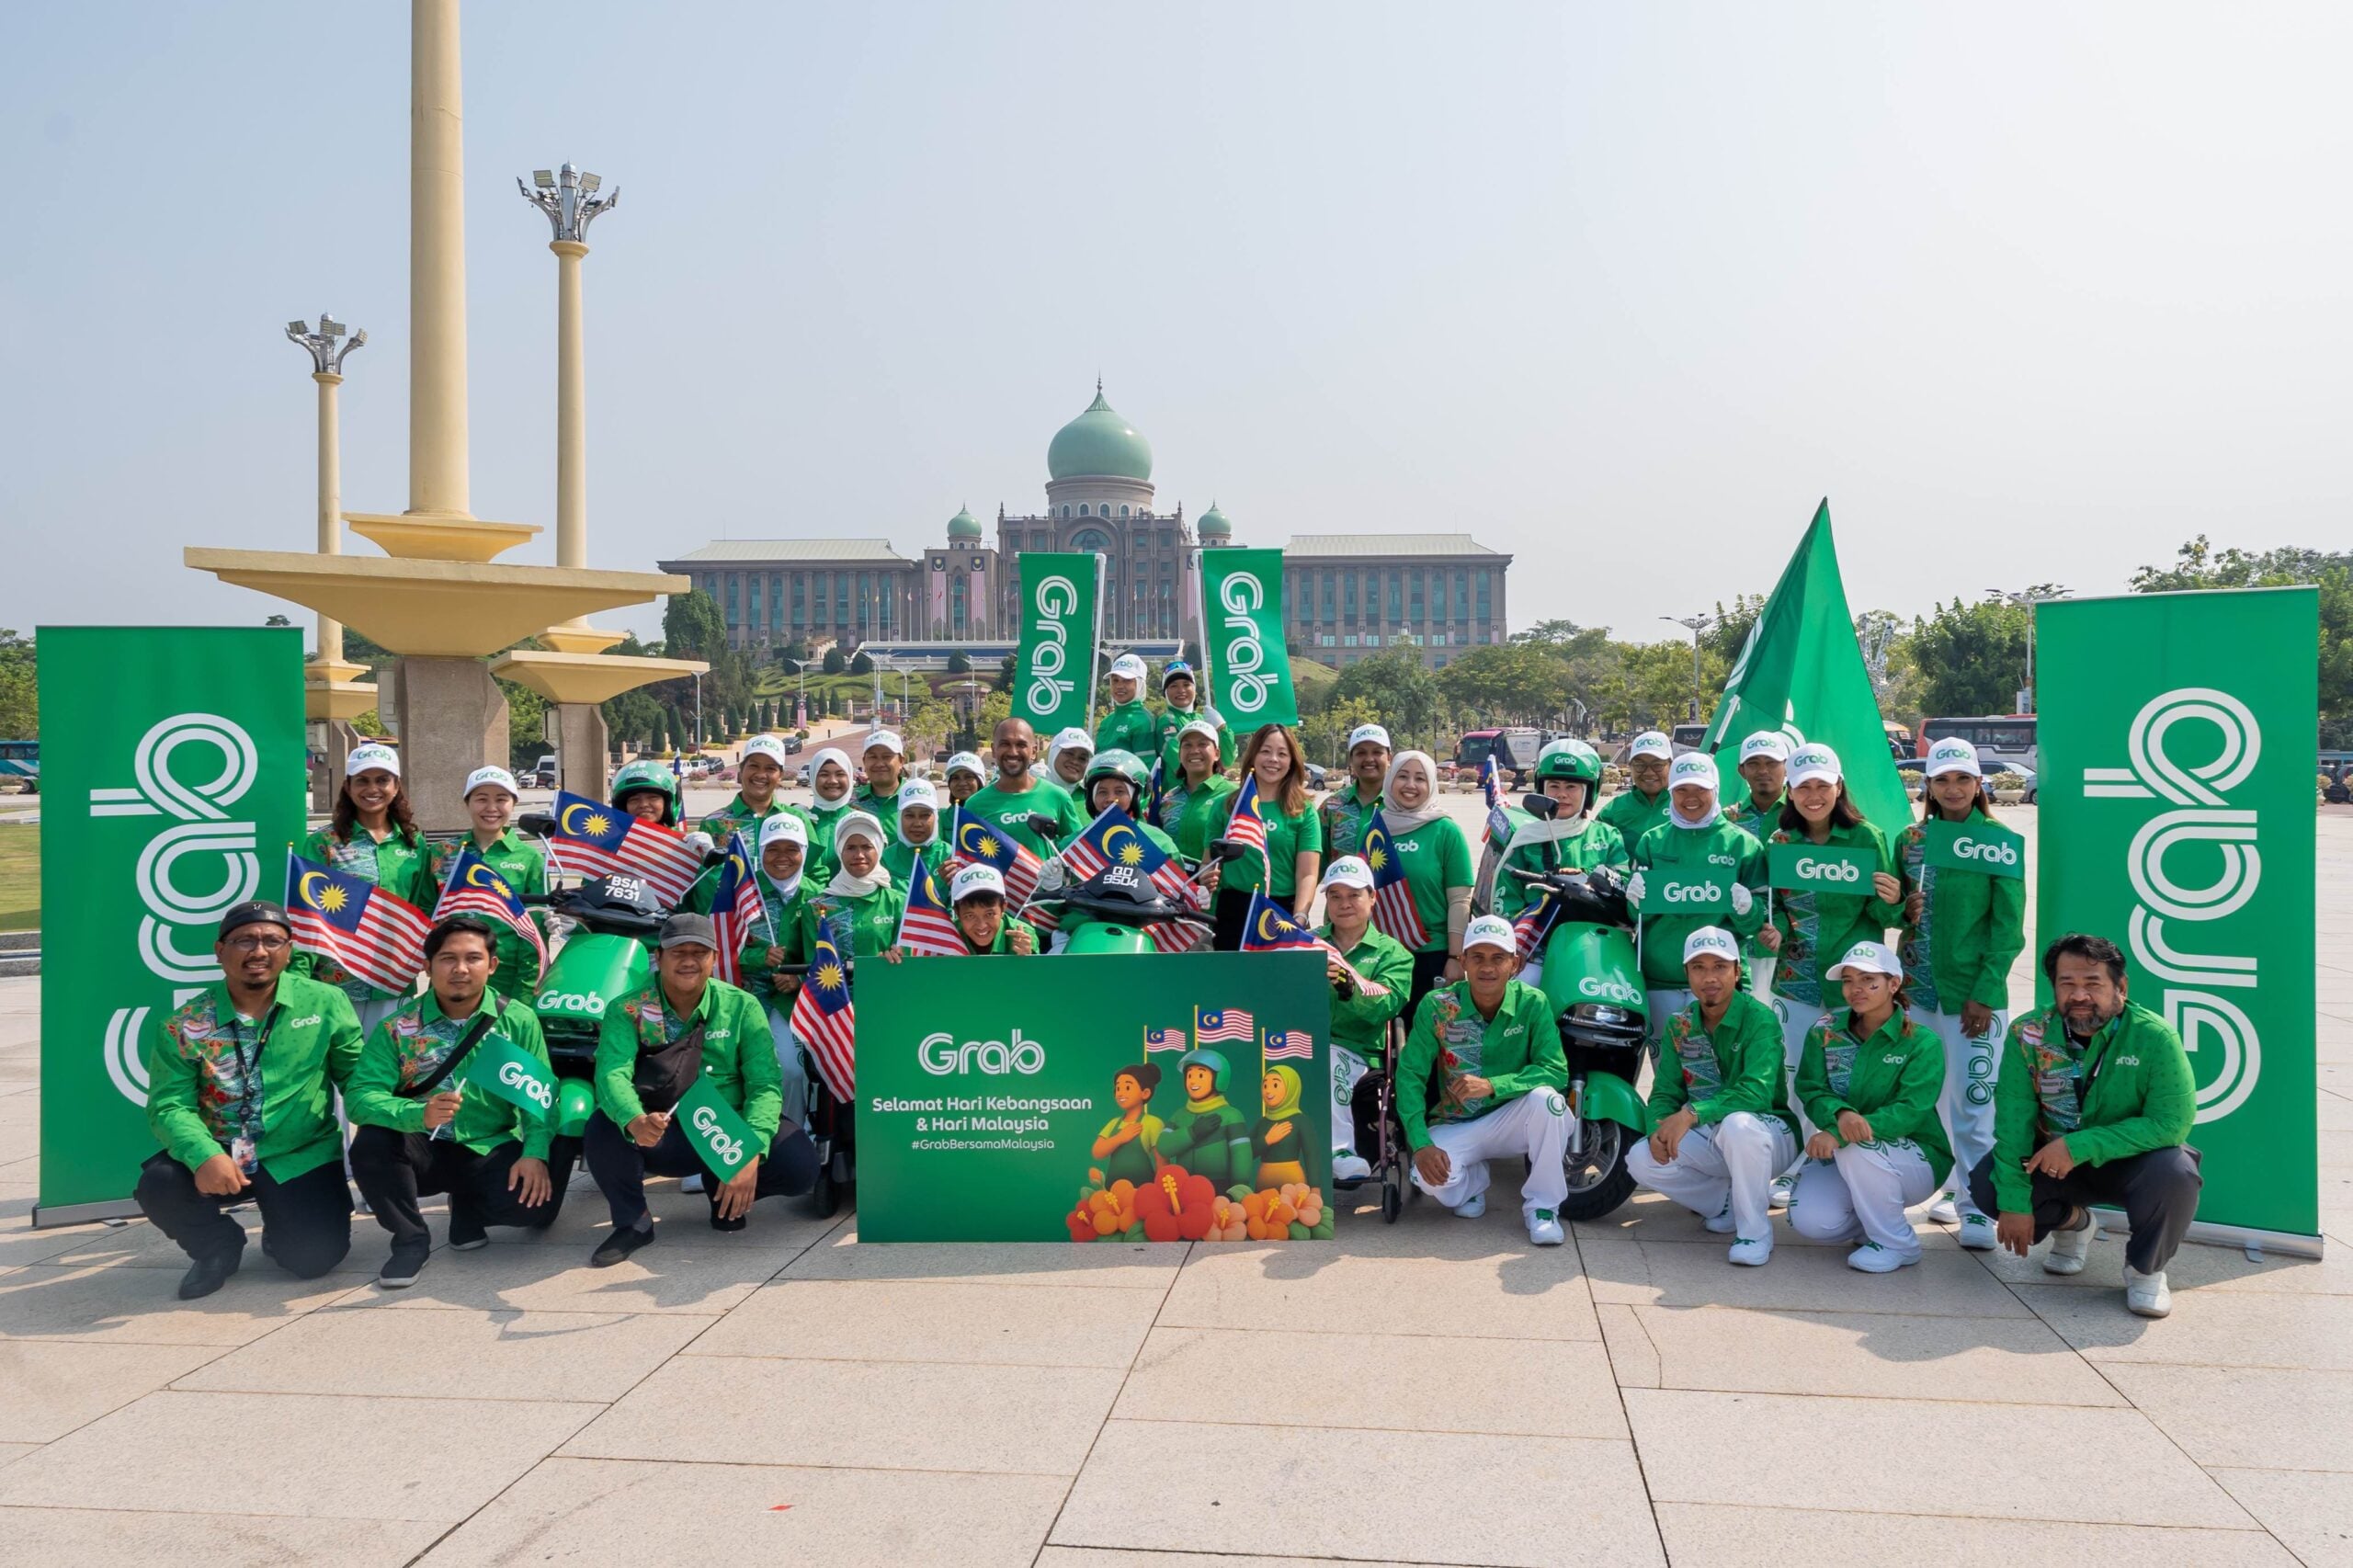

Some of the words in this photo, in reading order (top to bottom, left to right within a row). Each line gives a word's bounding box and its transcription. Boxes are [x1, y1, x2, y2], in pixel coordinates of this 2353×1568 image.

[1027, 575, 1078, 715] Grab
[1221, 572, 1279, 712] Grab
[751, 739, 779, 753] Grab
[1636, 738, 1663, 748] Grab
[1747, 738, 1777, 749] Grab
[357, 746, 392, 762] Grab
[951, 755, 976, 765] Grab
[1100, 756, 1121, 765] Grab
[1554, 756, 1577, 766] Grab
[1794, 753, 1828, 767] Grab
[1936, 748, 1972, 760] Grab
[626, 768, 649, 778] Grab
[1677, 763, 1708, 774] Grab
[475, 770, 508, 782] Grab
[904, 787, 931, 798] Grab
[768, 821, 799, 833] Grab
[394, 848, 417, 858] Grab
[1393, 839, 1419, 853] rab
[1953, 837, 2018, 866] Grab
[500, 861, 526, 871] Grab
[1708, 854, 1736, 867] Grab
[1329, 863, 1359, 877] Grab
[1796, 858, 1859, 882] Grab
[611, 876, 640, 891] BSA
[961, 871, 995, 884] Grab
[605, 885, 641, 902] 7631
[1664, 880, 1722, 903] Grab
[1473, 924, 1507, 937] Grab
[1692, 937, 1727, 949] Grab
[1579, 977, 1643, 1006] Grab
[537, 990, 605, 1014] Grab
[290, 1014, 321, 1029] Grab
[705, 1028, 732, 1040] Grab
[918, 1028, 1046, 1075] Grab
[499, 1062, 552, 1109] Grab
[872, 1097, 941, 1111] Selamat
[947, 1097, 981, 1110] Hari
[986, 1096, 1092, 1114] Kebangsaan
[916, 1118, 926, 1131] &
[932, 1117, 966, 1131] Hari
[972, 1117, 1049, 1134] Malaysia
[693, 1107, 743, 1165] Grab
[912, 1139, 1054, 1152] #GrabBersamaMalaysia
